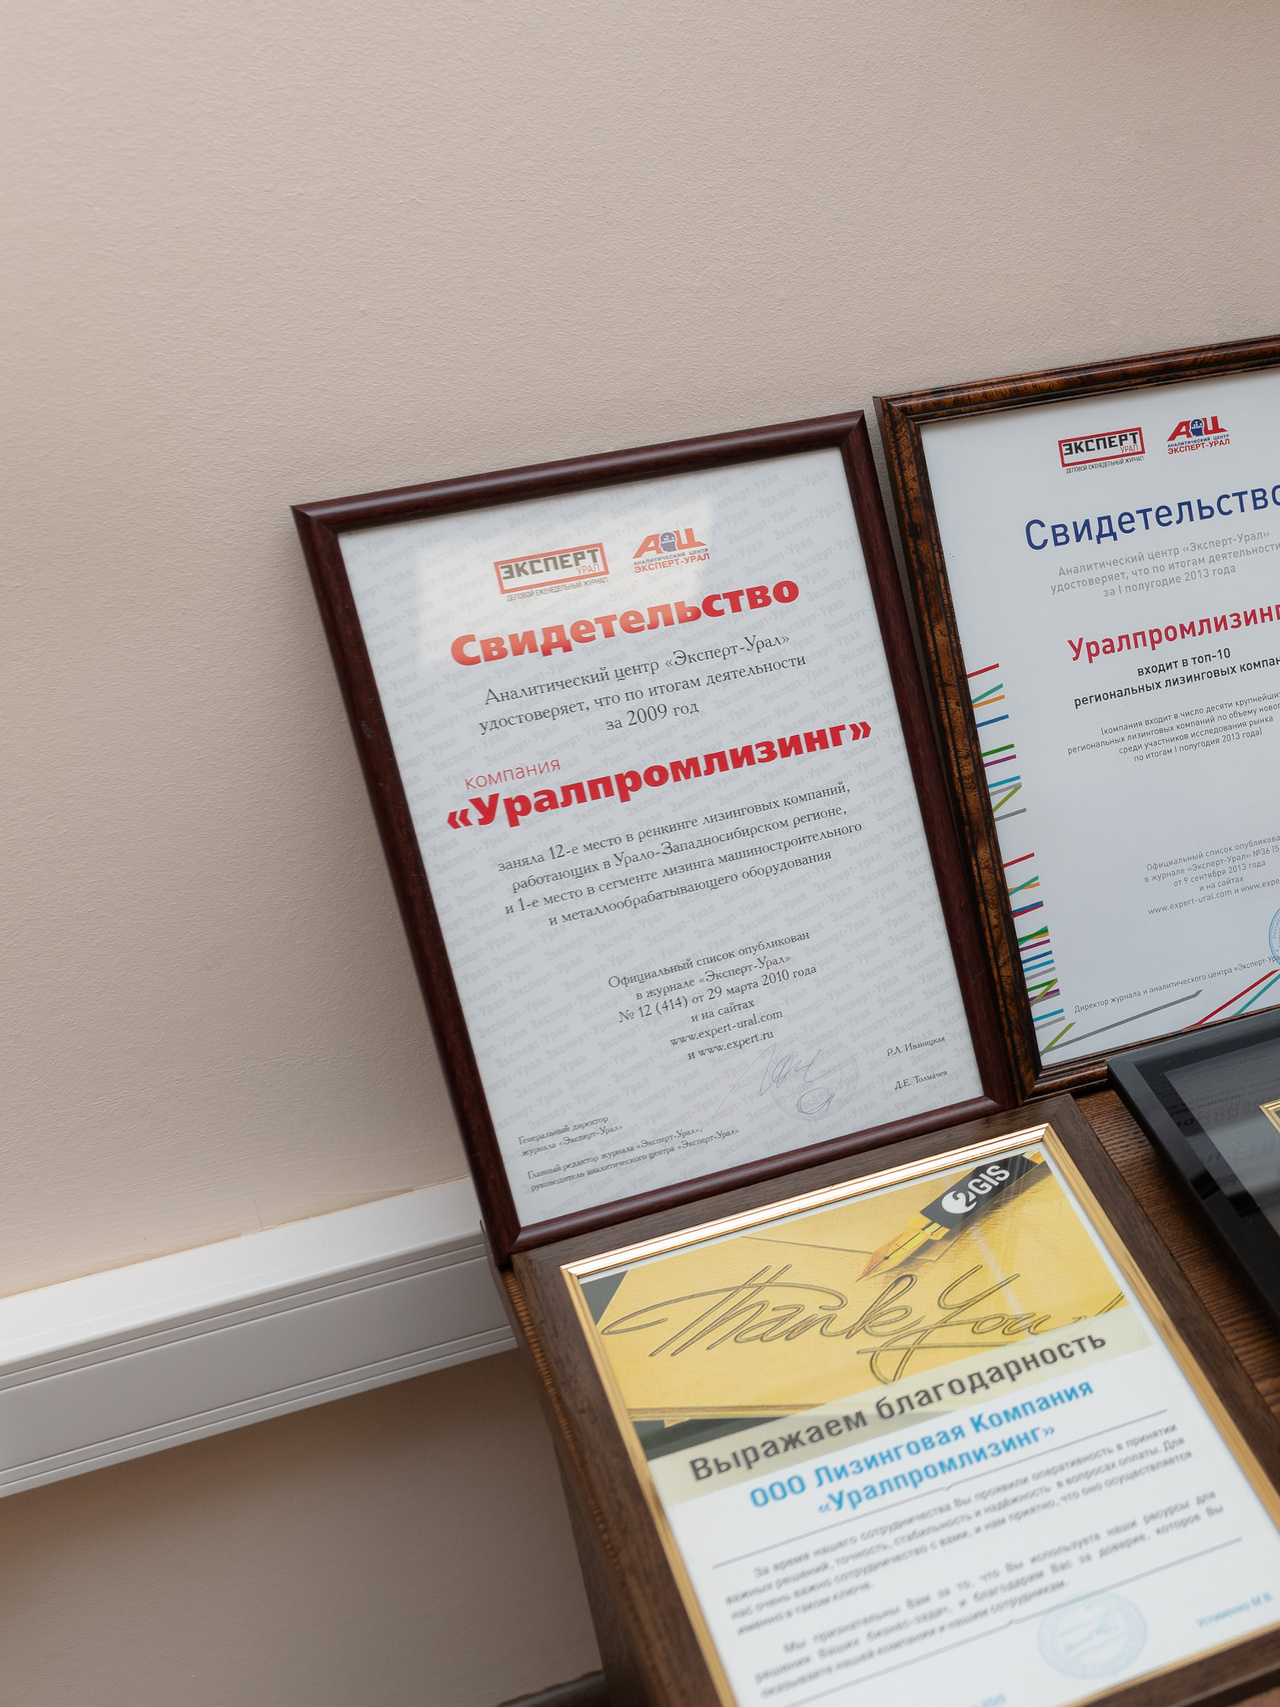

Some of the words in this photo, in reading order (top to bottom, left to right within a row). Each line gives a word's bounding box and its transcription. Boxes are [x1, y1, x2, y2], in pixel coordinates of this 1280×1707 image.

[1062, 432, 1139, 456] ЭКСПЕРТ
[1120, 444, 1139, 454] УРАЛ
[1167, 438, 1231, 455] ЭКСПЕРТ-УРАЛ
[500, 548, 600, 580] ЭКСПЕРТ
[575, 563, 600, 576] УРАЛ
[633, 553, 711, 574] ЭКСПЕРТ-УРАЛ
[1057, 550, 1145, 577] Аналитический
[1146, 546, 1180, 561] центр
[1181, 530, 1270, 553] «Эксперт-Урал»
[1049, 570, 1129, 596] удостоверяет,
[1130, 566, 1150, 577] что
[1151, 563, 1166, 574] по
[1167, 555, 1206, 571] итогам
[1102, 587, 1116, 598] за
[1123, 574, 1182, 593] полугодие
[1183, 566, 1210, 582] 2013
[1211, 564, 1237, 577] года
[450, 579, 800, 666] Свидетельство
[484, 665, 610, 705] Аналитический
[612, 660, 660, 682] центр
[664, 633, 790, 667] «Эксперт-Урал»
[1136, 659, 1179, 677] входит
[1180, 657, 1189, 668] в
[1189, 646, 1231, 665] топ-10
[477, 700, 590, 736] удостоверяет,
[592, 693, 621, 707] что
[623, 688, 644, 702] по
[647, 676, 702, 697] итогам
[705, 655, 807, 687] деятельности
[1073, 679, 1162, 710] региональных
[1163, 664, 1237, 688] лизинговых
[604, 718, 623, 731] за
[625, 702, 668, 727] 2009
[672, 702, 700, 717] год
[1066, 735, 1126, 755] региональных
[1126, 724, 1175, 741] лизинговых
[1174, 714, 1216, 731] компаний
[1216, 713, 1228, 722] по
[1227, 707, 1257, 719] объему
[1117, 742, 1143, 755] среди
[1143, 732, 1189, 750] участников
[1189, 720, 1247, 738] исследования
[1247, 714, 1274, 728] рынка
[1143, 713, 1172, 726] входит
[1172, 712, 1179, 720] в
[1178, 706, 1205, 718] число
[1204, 701, 1234, 714] десяти
[1132, 753, 1144, 762] по
[1144, 747, 1173, 760] итогам
[1178, 737, 1220, 752] полугодия
[1220, 730, 1241, 743] 2013
[446, 720, 872, 830] «Уралпромлизинг»
[463, 758, 561, 790] компания
[496, 853, 545, 872] заняла
[547, 843, 579, 860] 12-е
[581, 835, 622, 852] место
[624, 832, 635, 843] в
[637, 817, 699, 843] ренкинге
[701, 799, 781, 825] лизинговых
[781, 779, 850, 807] компаний,
[504, 904, 514, 915] и
[517, 896, 539, 911] 1-е
[542, 888, 583, 906] место
[585, 885, 596, 895] в
[597, 870, 658, 892] сегменте
[661, 857, 715, 878] лизинга
[716, 822, 862, 864] машиностроительного
[511, 862, 600, 894] работающих
[601, 859, 612, 870] в
[612, 818, 790, 868] Урало-Западносибирском
[791, 805, 847, 829] регионе,
[547, 915, 558, 926] и
[560, 872, 739, 923] металлообрабатывающего
[740, 850, 832, 880] оборудования
[617, 1008, 635, 1023] №
[637, 1003, 653, 1018] 12
[654, 994, 688, 1016] (414)
[690, 993, 705, 1004] от
[705, 985, 723, 1001] 29
[724, 980, 759, 996] марта
[760, 967, 790, 987] 2010
[791, 965, 817, 979] года
[668, 1009, 784, 1046] www.expert-ural.com
[686, 1050, 696, 1061] и
[696, 1030, 774, 1057] www.expert.ru
[942, 1164, 1011, 1215] 2GIS
[688, 1409, 868, 1481] Выражаем
[874, 1333, 1106, 1420] благодарность
[749, 1474, 806, 1507] ООО
[813, 1424, 966, 1487] Лизинговая
[968, 1381, 1094, 1433] Компания
[818, 1426, 1055, 1511] «Уралпромлизинг»
